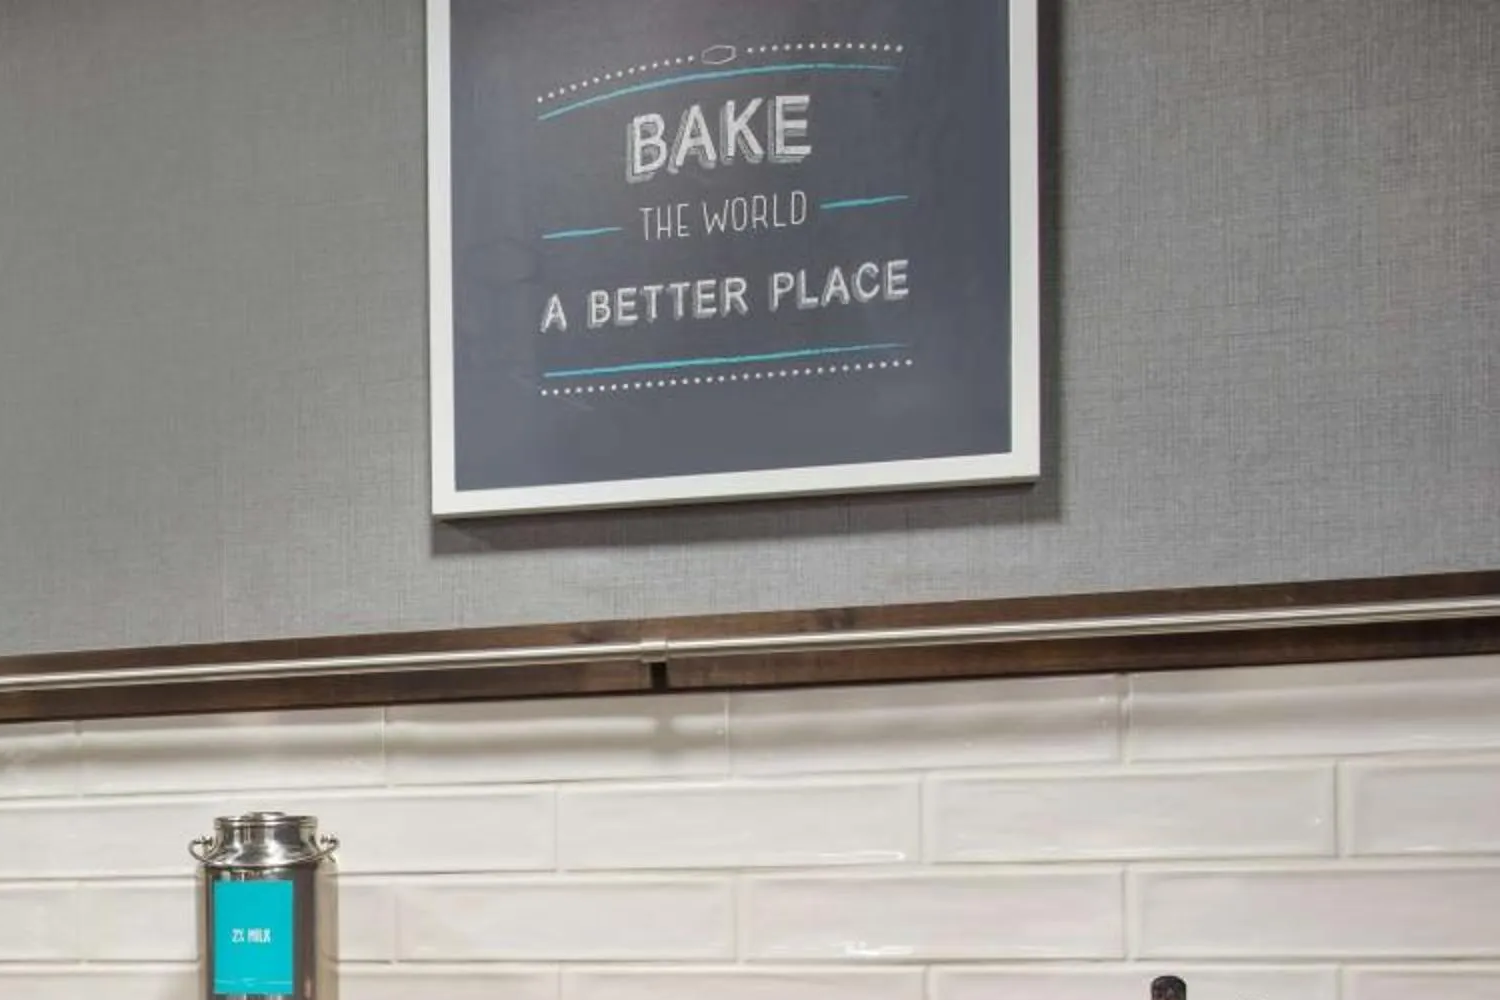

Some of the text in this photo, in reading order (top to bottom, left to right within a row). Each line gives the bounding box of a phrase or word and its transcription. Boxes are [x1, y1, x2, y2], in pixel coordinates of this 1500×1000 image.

[626, 95, 812, 183] BAKE
[639, 190, 808, 241] THE WORLD
[540, 259, 909, 333] A BETTER PLACE
